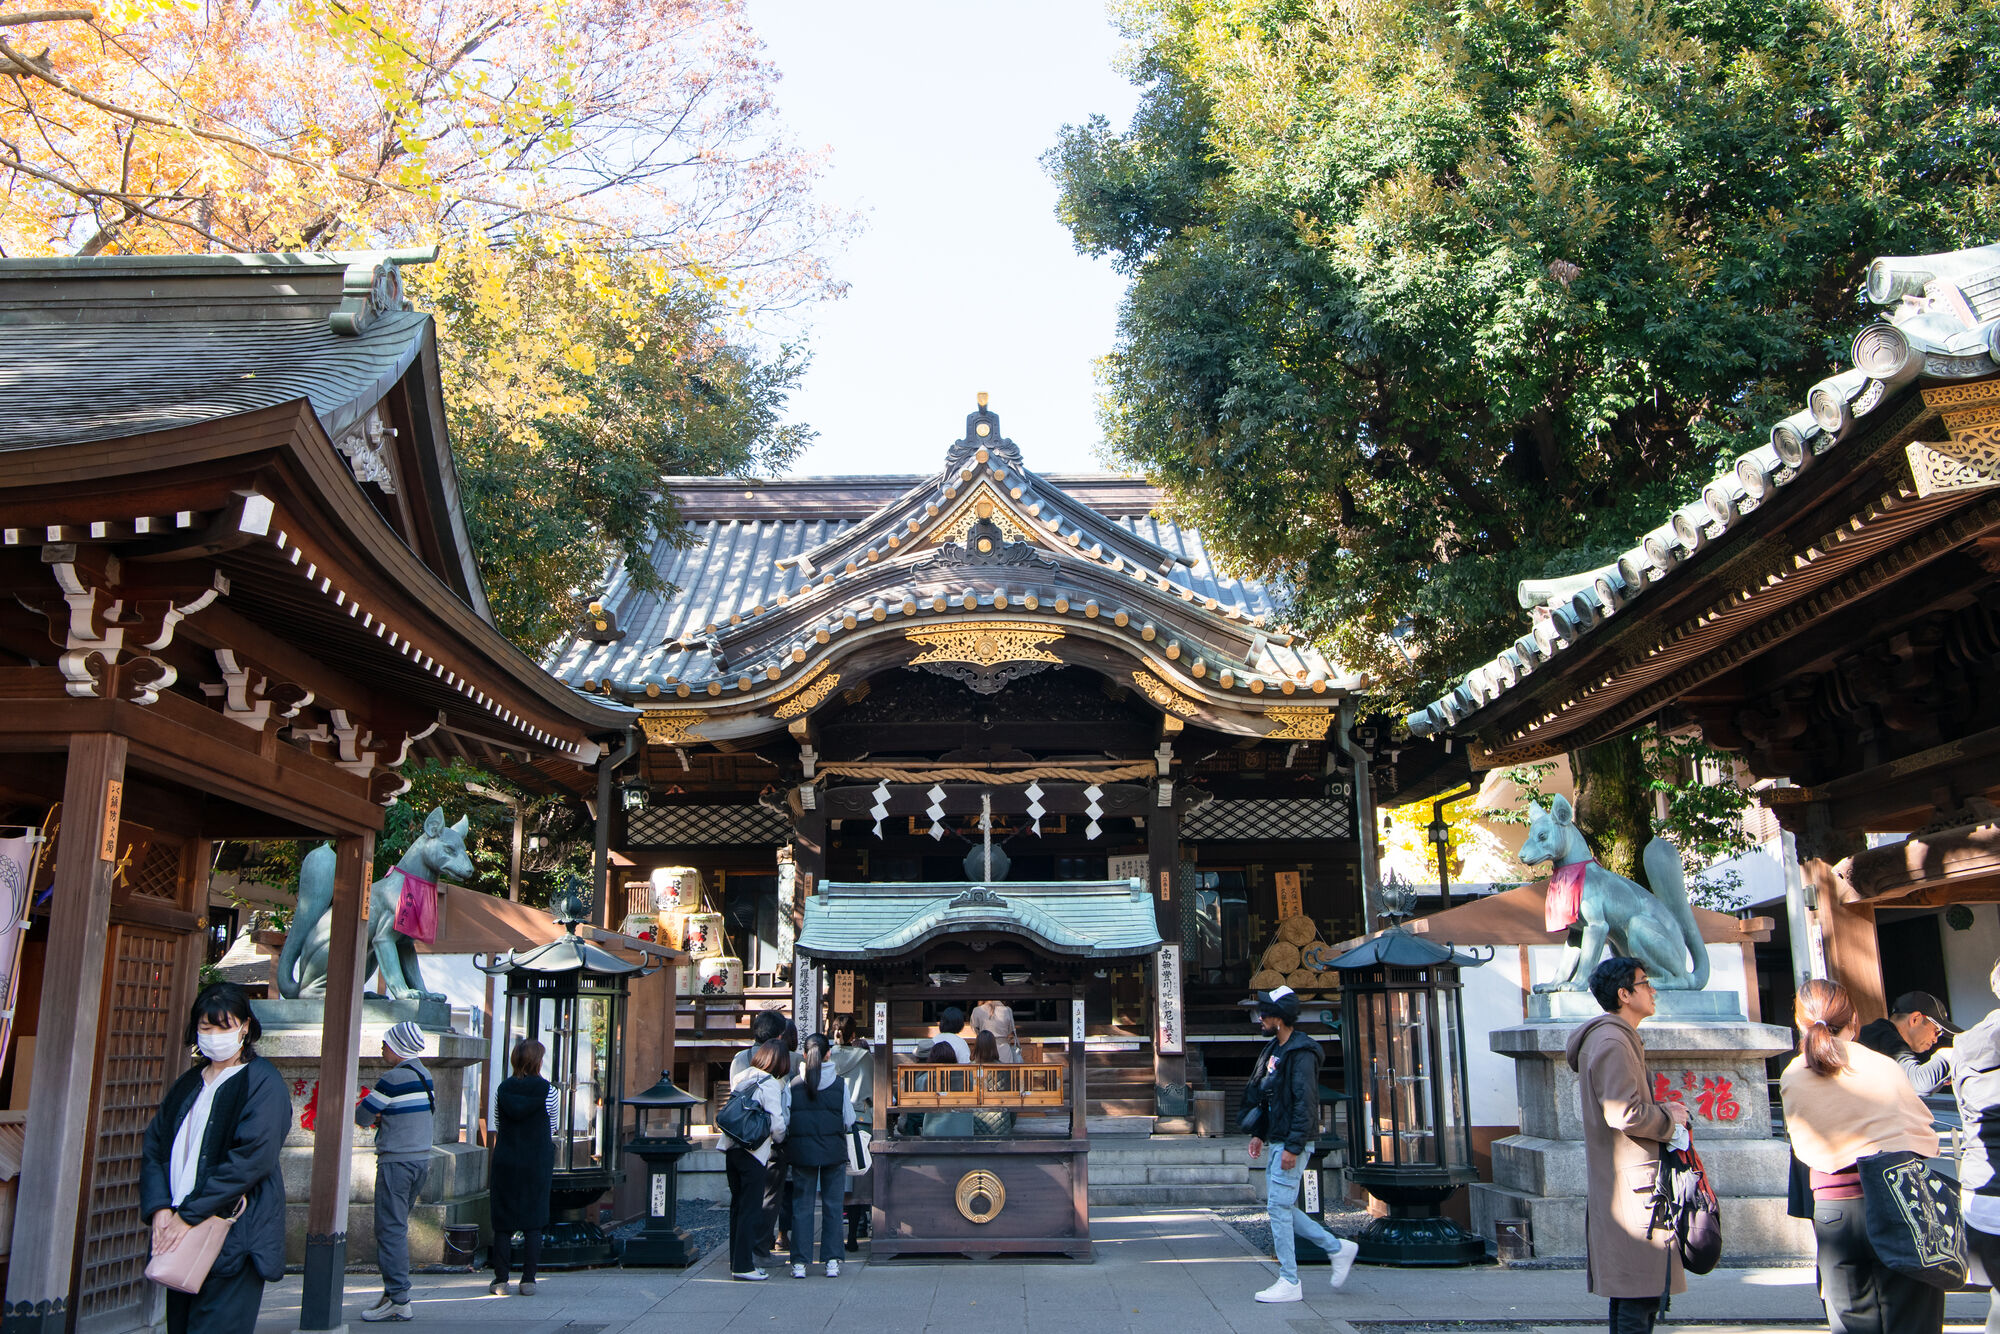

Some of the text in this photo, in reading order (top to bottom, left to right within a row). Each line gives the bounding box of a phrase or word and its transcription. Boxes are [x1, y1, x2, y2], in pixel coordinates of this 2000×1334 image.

[293, 1078, 307, 1096] 京
[1682, 1070, 1698, 1091] 東
[1696, 1076, 1740, 1120] 福
